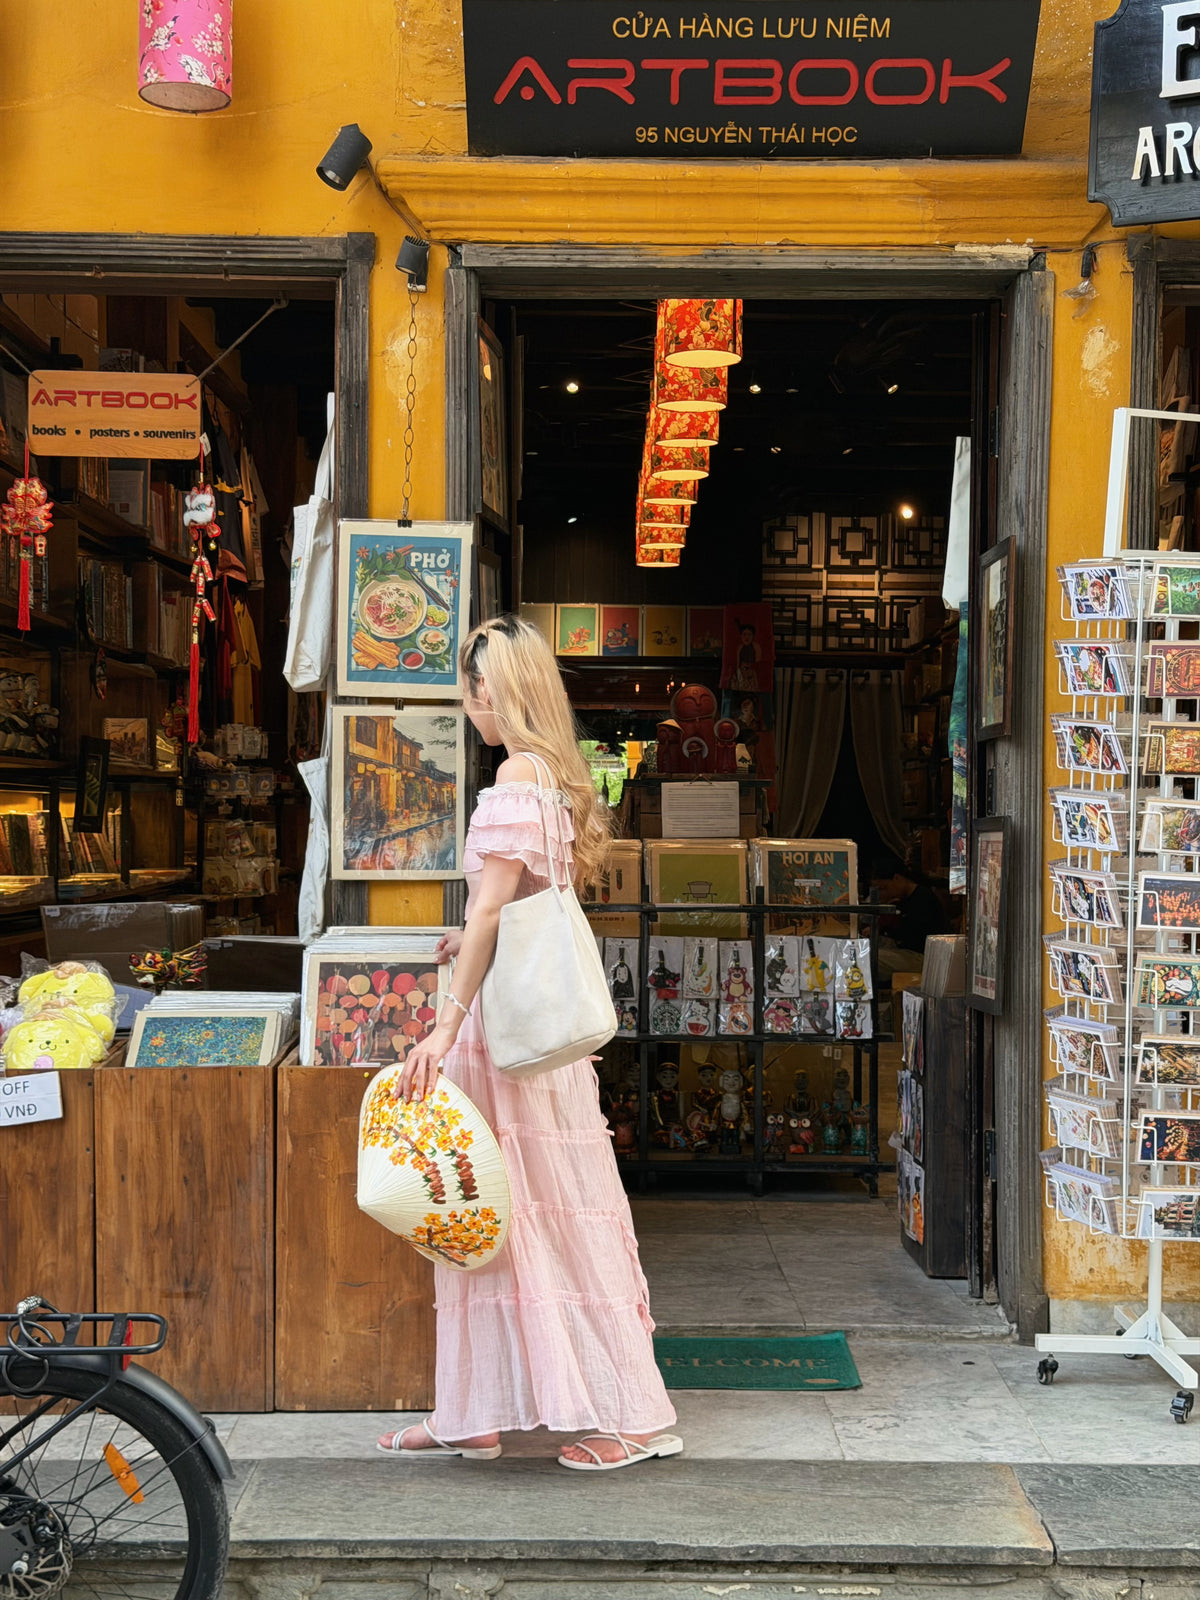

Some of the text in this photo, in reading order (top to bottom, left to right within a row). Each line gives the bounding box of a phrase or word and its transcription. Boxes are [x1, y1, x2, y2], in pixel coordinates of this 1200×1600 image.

[612, 11, 891, 42] CỬA HÀNG LƯU NIỆM
[493, 56, 1011, 105] ARTBOOK
[635, 121, 858, 146] 95 NGUYỄN THÁI HỌC
[1131, 121, 1200, 180] AR
[31, 388, 198, 410] ARTBOOK
[32, 424, 197, 440] books posters souvenirs
[410, 548, 451, 568] PHỞ
[782, 852, 835, 865] HOI AN
[2, 1081, 30, 1096] OFF
[4, 1103, 37, 1118] VNĐ
[663, 1357, 830, 1368] ELCOME
